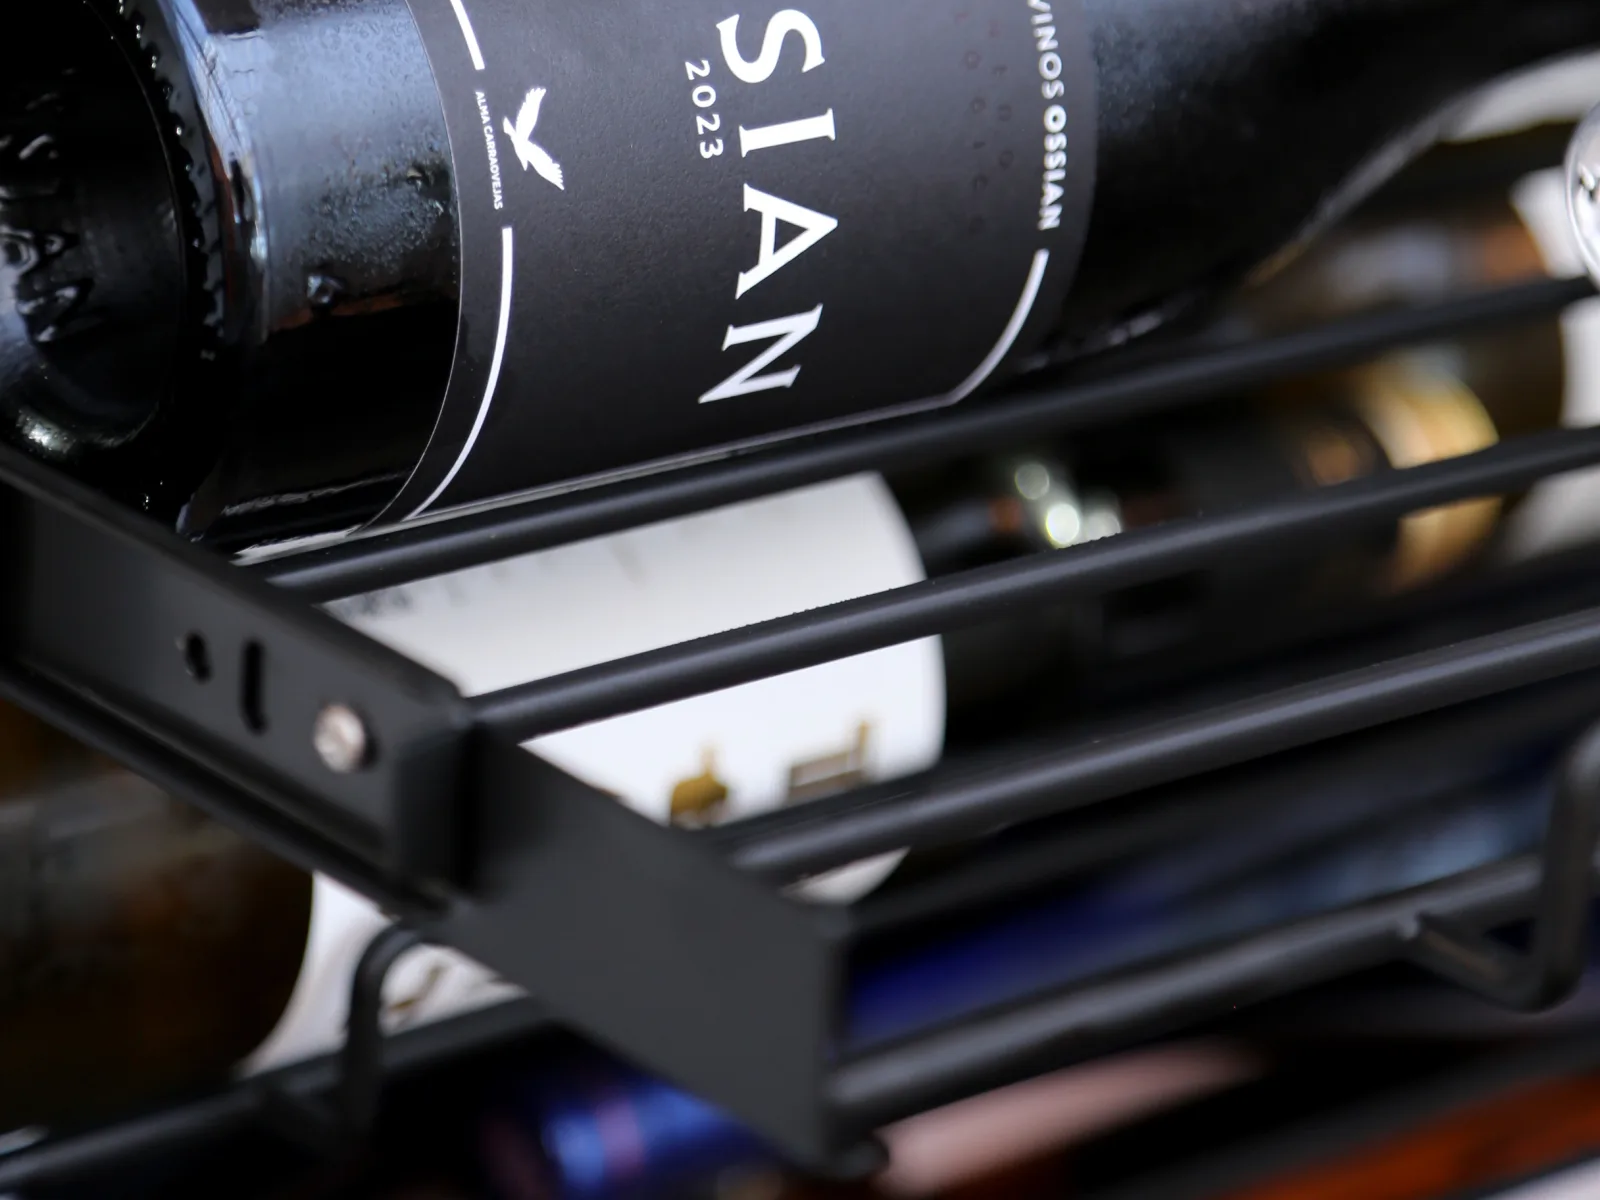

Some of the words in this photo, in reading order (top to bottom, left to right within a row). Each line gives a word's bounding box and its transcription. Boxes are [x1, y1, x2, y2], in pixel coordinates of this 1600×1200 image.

[475, 91, 491, 124] ALMA
[483, 125, 503, 210] CARRAOVEJAS
[684, 57, 725, 161] 2023
[1038, 104, 1068, 231] OSSIAN
